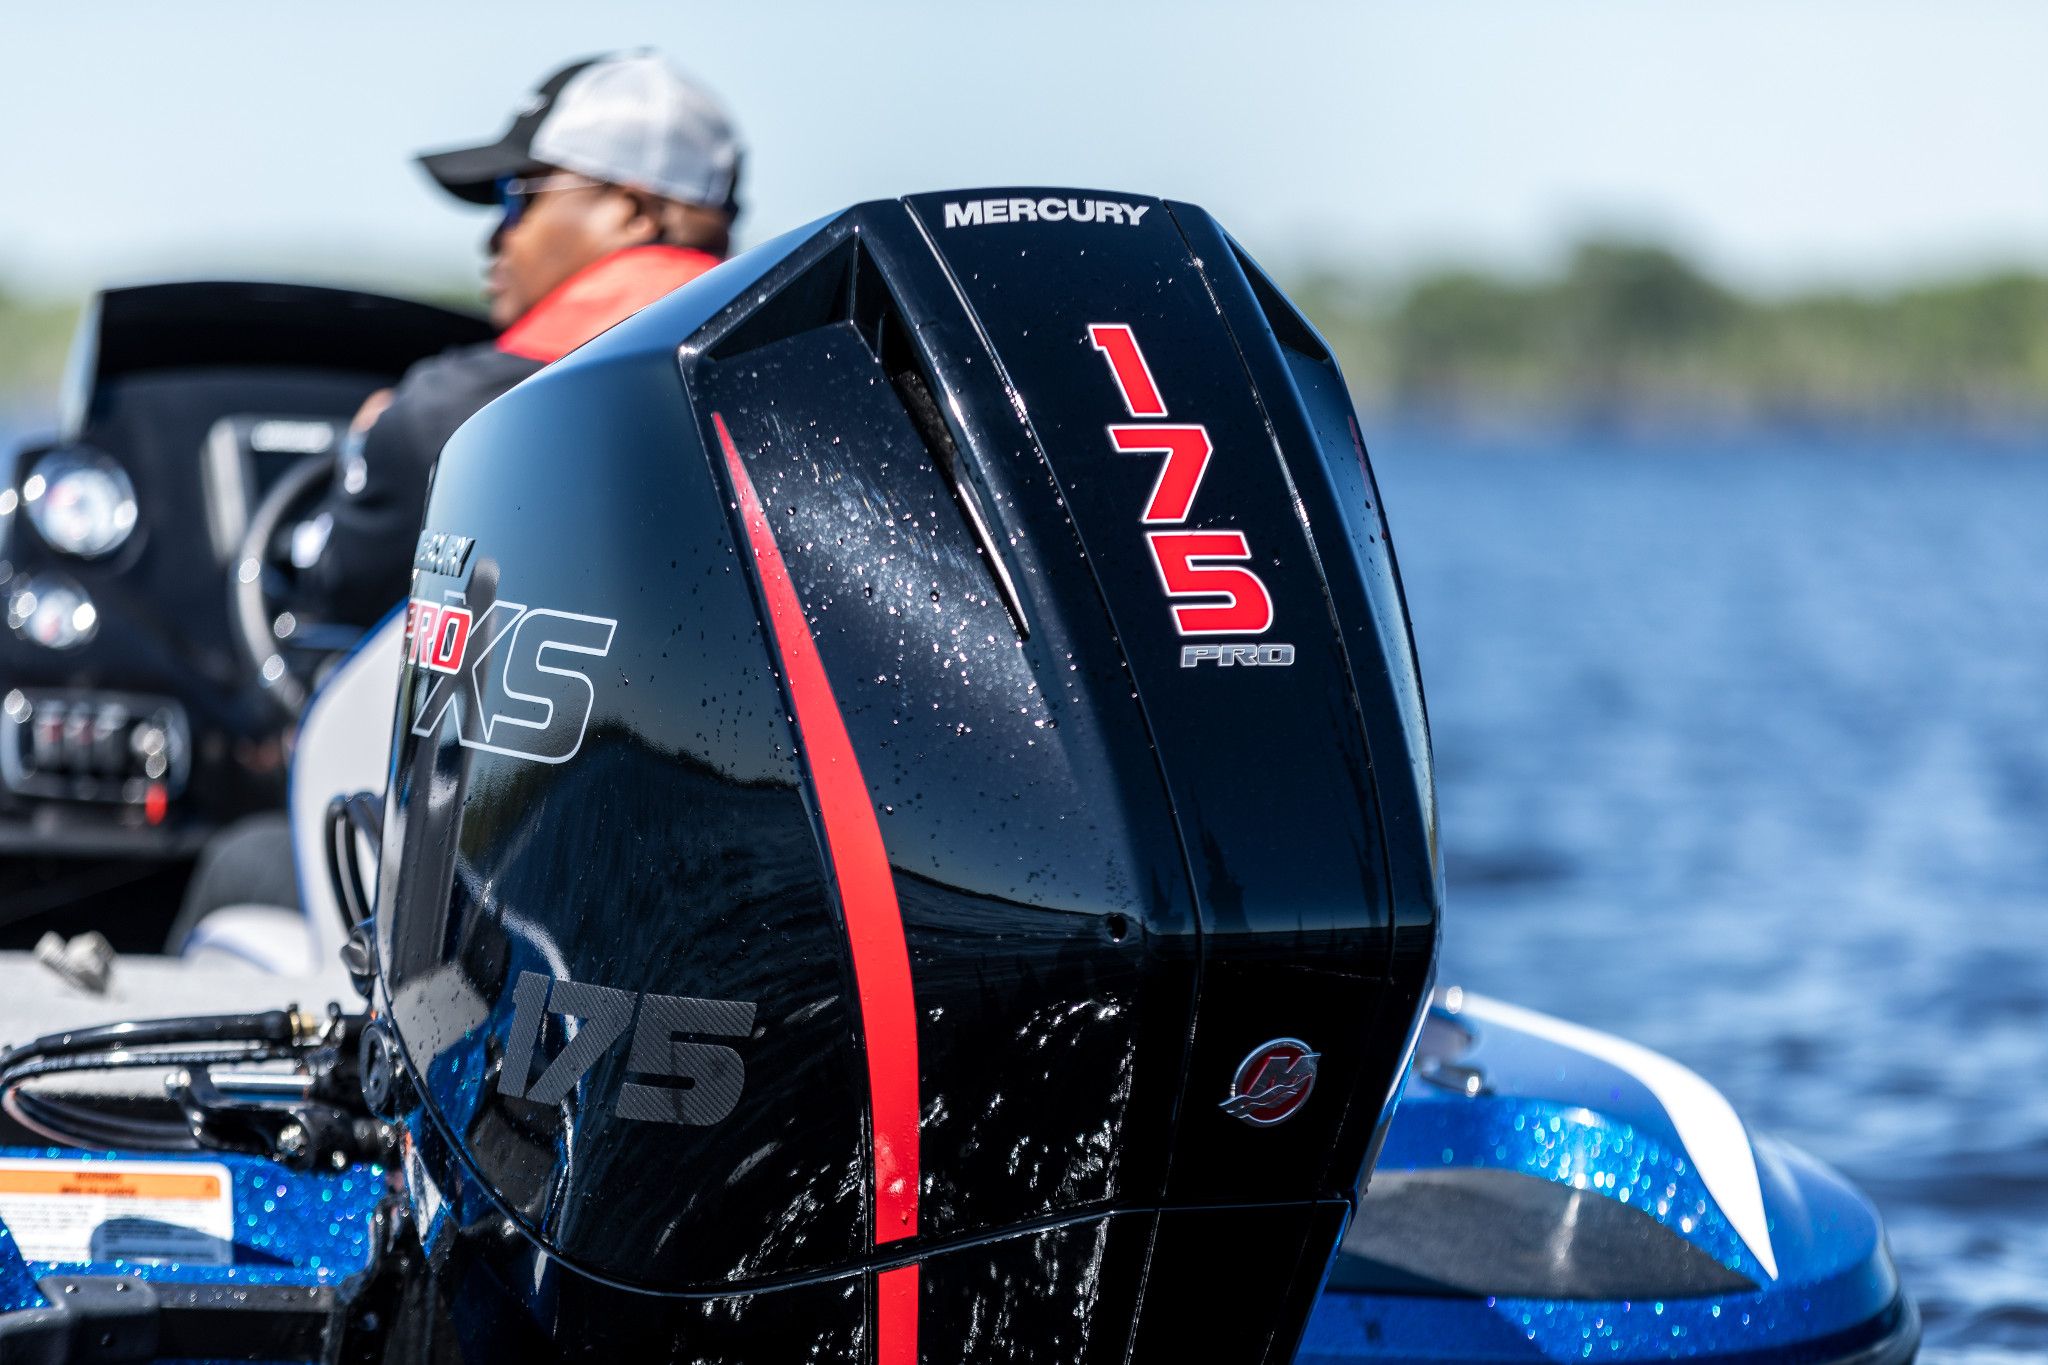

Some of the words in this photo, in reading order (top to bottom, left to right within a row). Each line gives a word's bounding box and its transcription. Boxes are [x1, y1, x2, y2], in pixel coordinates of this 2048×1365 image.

[944, 198, 1150, 229] MERCURY
[1086, 323, 1275, 637] 175
[411, 589, 618, 764] XS
[1180, 643, 1295, 668] PRO
[496, 970, 758, 1127] 175
